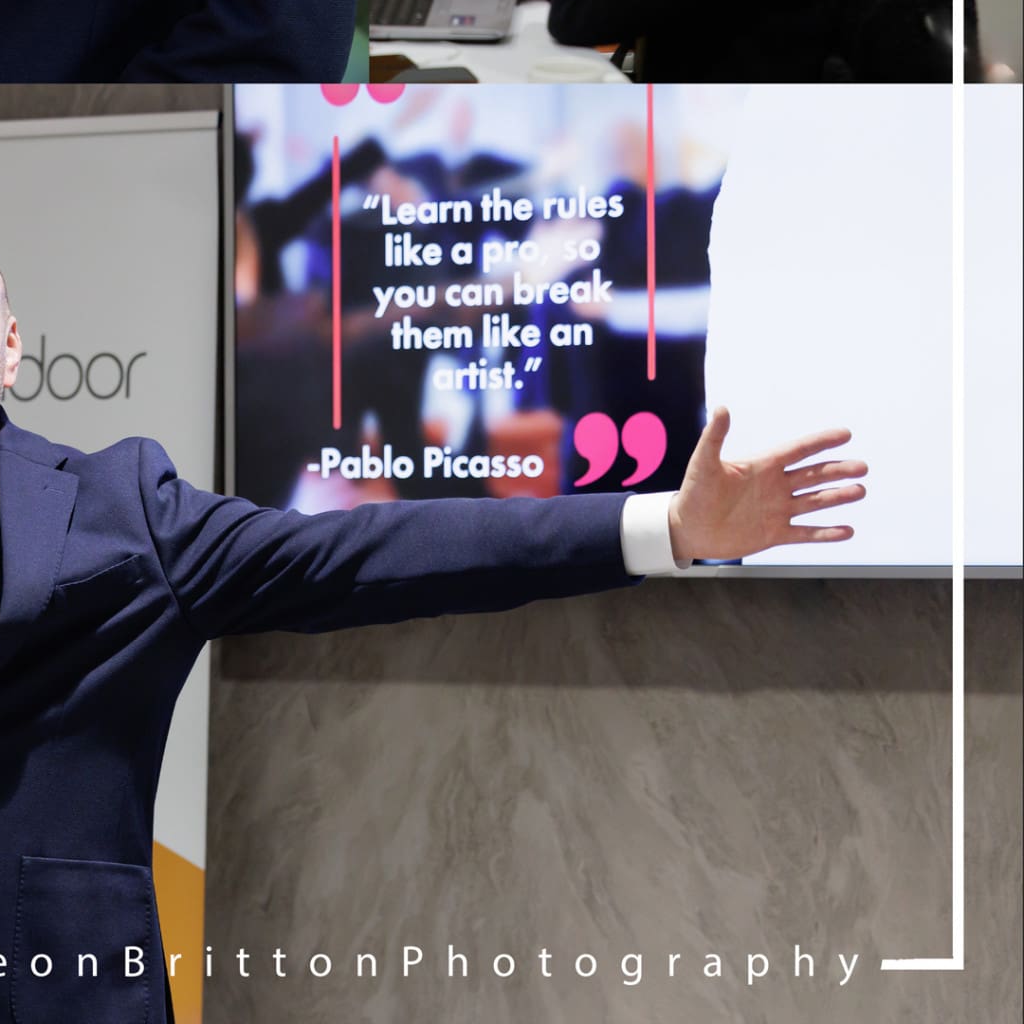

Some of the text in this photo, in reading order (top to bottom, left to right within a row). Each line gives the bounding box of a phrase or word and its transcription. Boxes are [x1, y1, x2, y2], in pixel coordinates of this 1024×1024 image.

[363, 186, 624, 226] “Learn the rules
[384, 233, 601, 273] like a pro, so
[373, 270, 613, 318] you can break
[391, 313, 593, 350] them like an
[6, 334, 147, 403] door
[433, 357, 542, 391] artist.”
[307, 445, 544, 479] -Pablo Picasso
